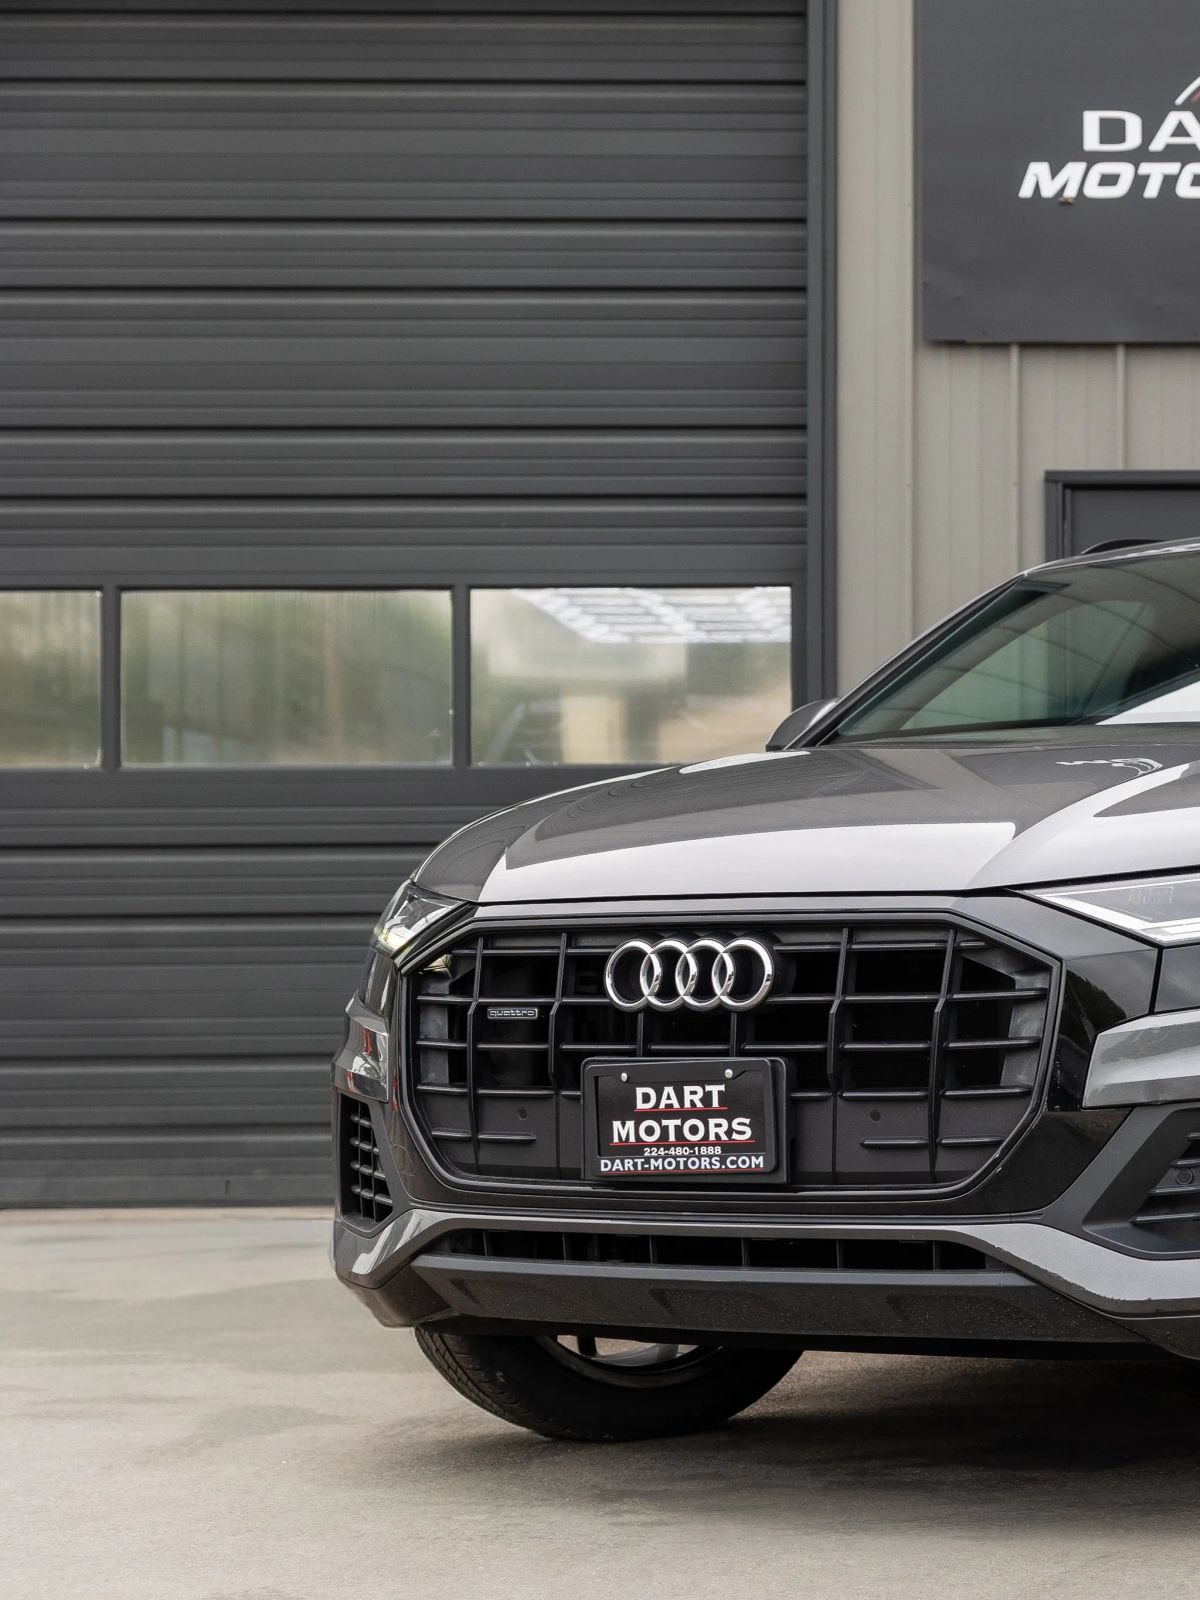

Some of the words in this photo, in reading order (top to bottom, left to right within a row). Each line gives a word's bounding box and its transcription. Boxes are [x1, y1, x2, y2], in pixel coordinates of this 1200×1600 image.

[635, 1085, 725, 1109] DART
[612, 1118, 752, 1143] MOTORS
[643, 1146, 722, 1156] 224-480-1888
[600, 1156, 764, 1171] DART-MOTORS.COM
